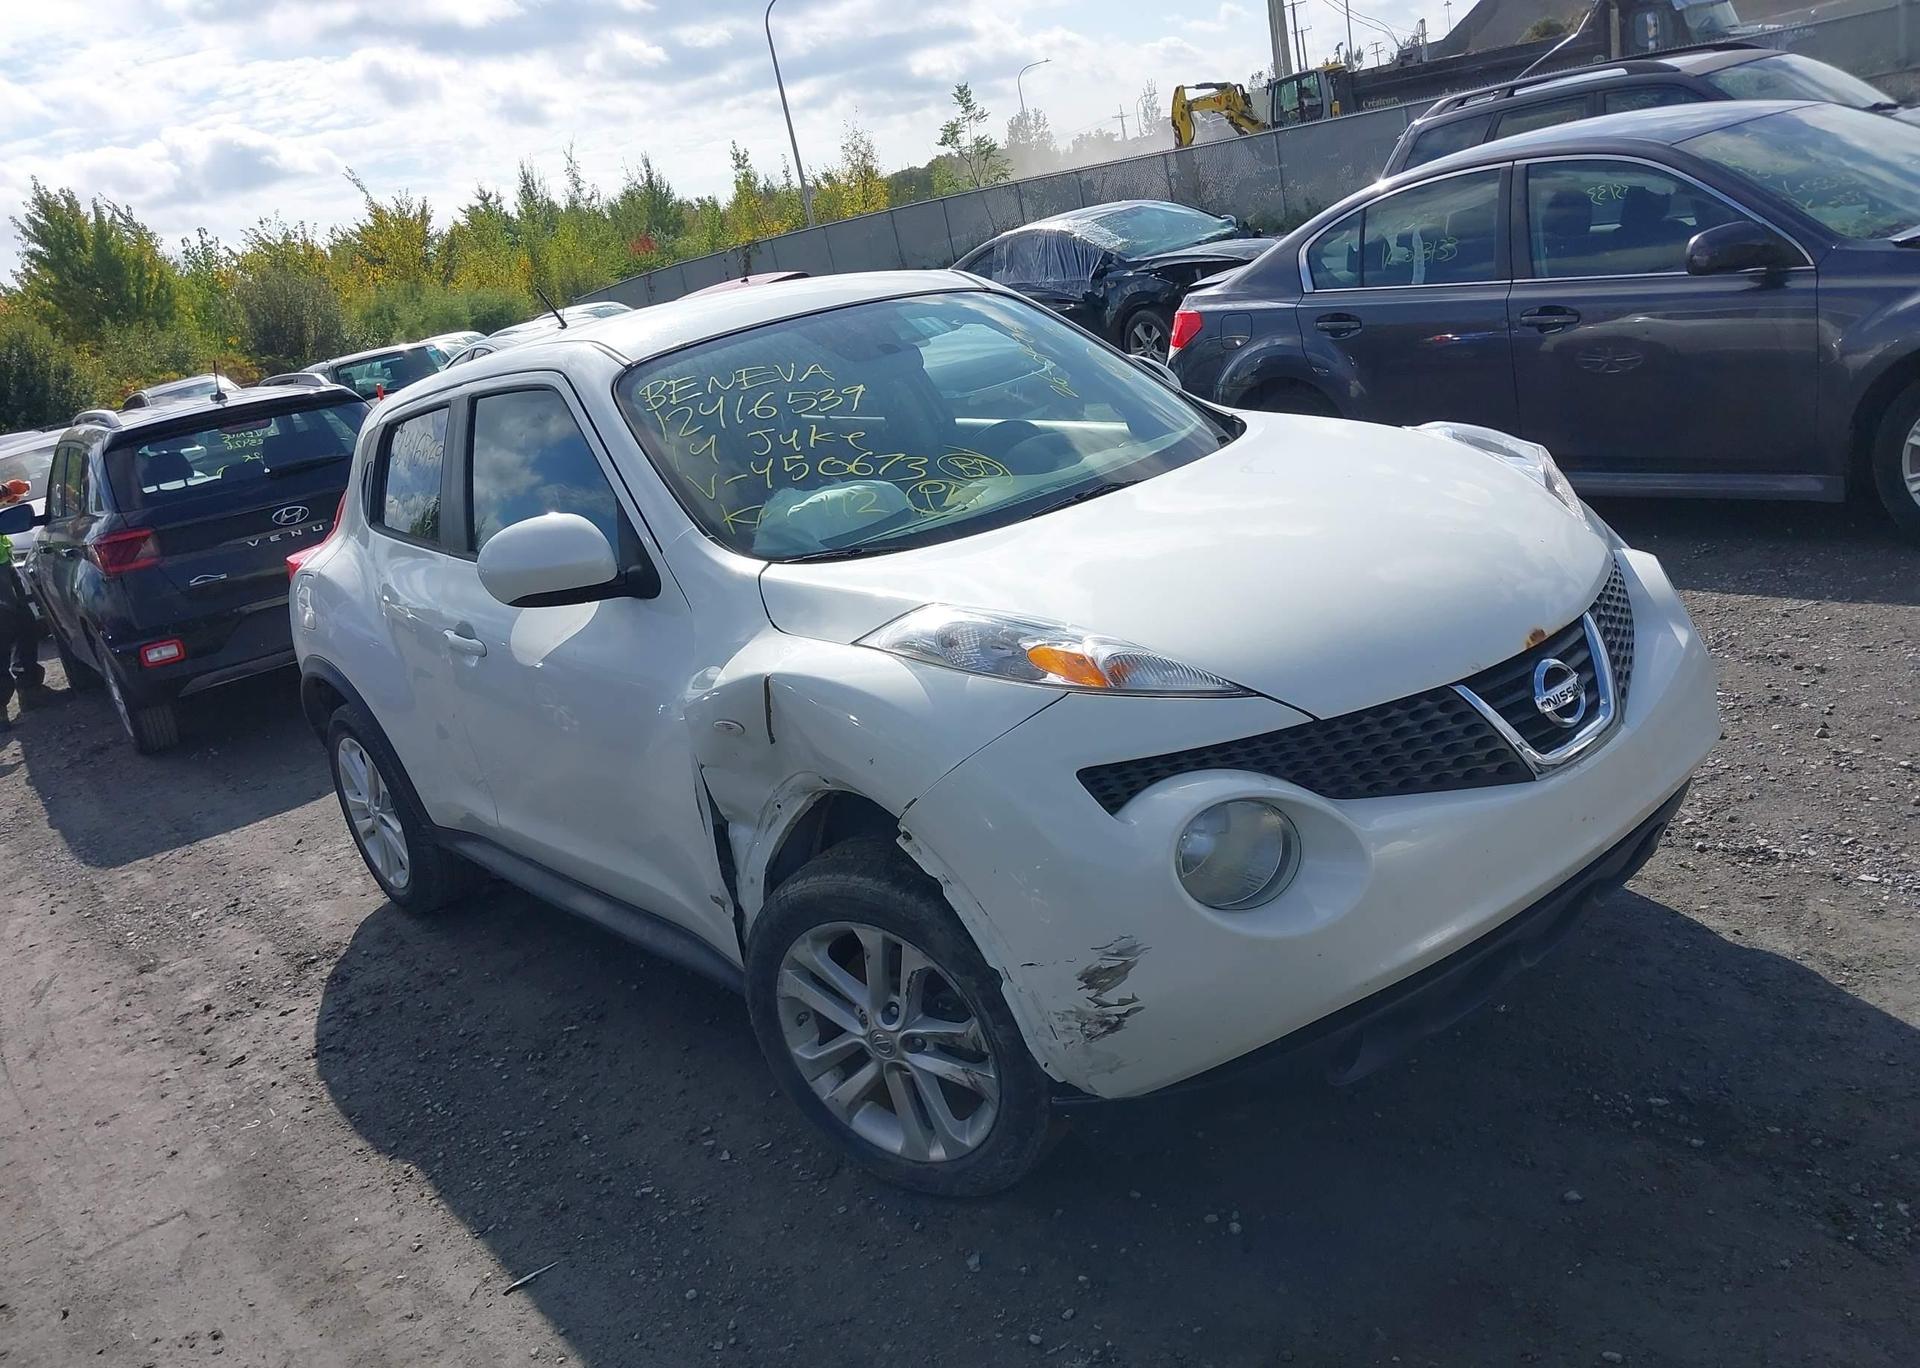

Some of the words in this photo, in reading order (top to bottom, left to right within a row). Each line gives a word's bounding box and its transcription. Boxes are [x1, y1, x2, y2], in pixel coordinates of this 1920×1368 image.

[639, 363, 835, 411] BENEVA
[655, 384, 866, 442] 12416539
[247, 524, 324, 547] VENU
[1545, 680, 1584, 708] NISSAN
